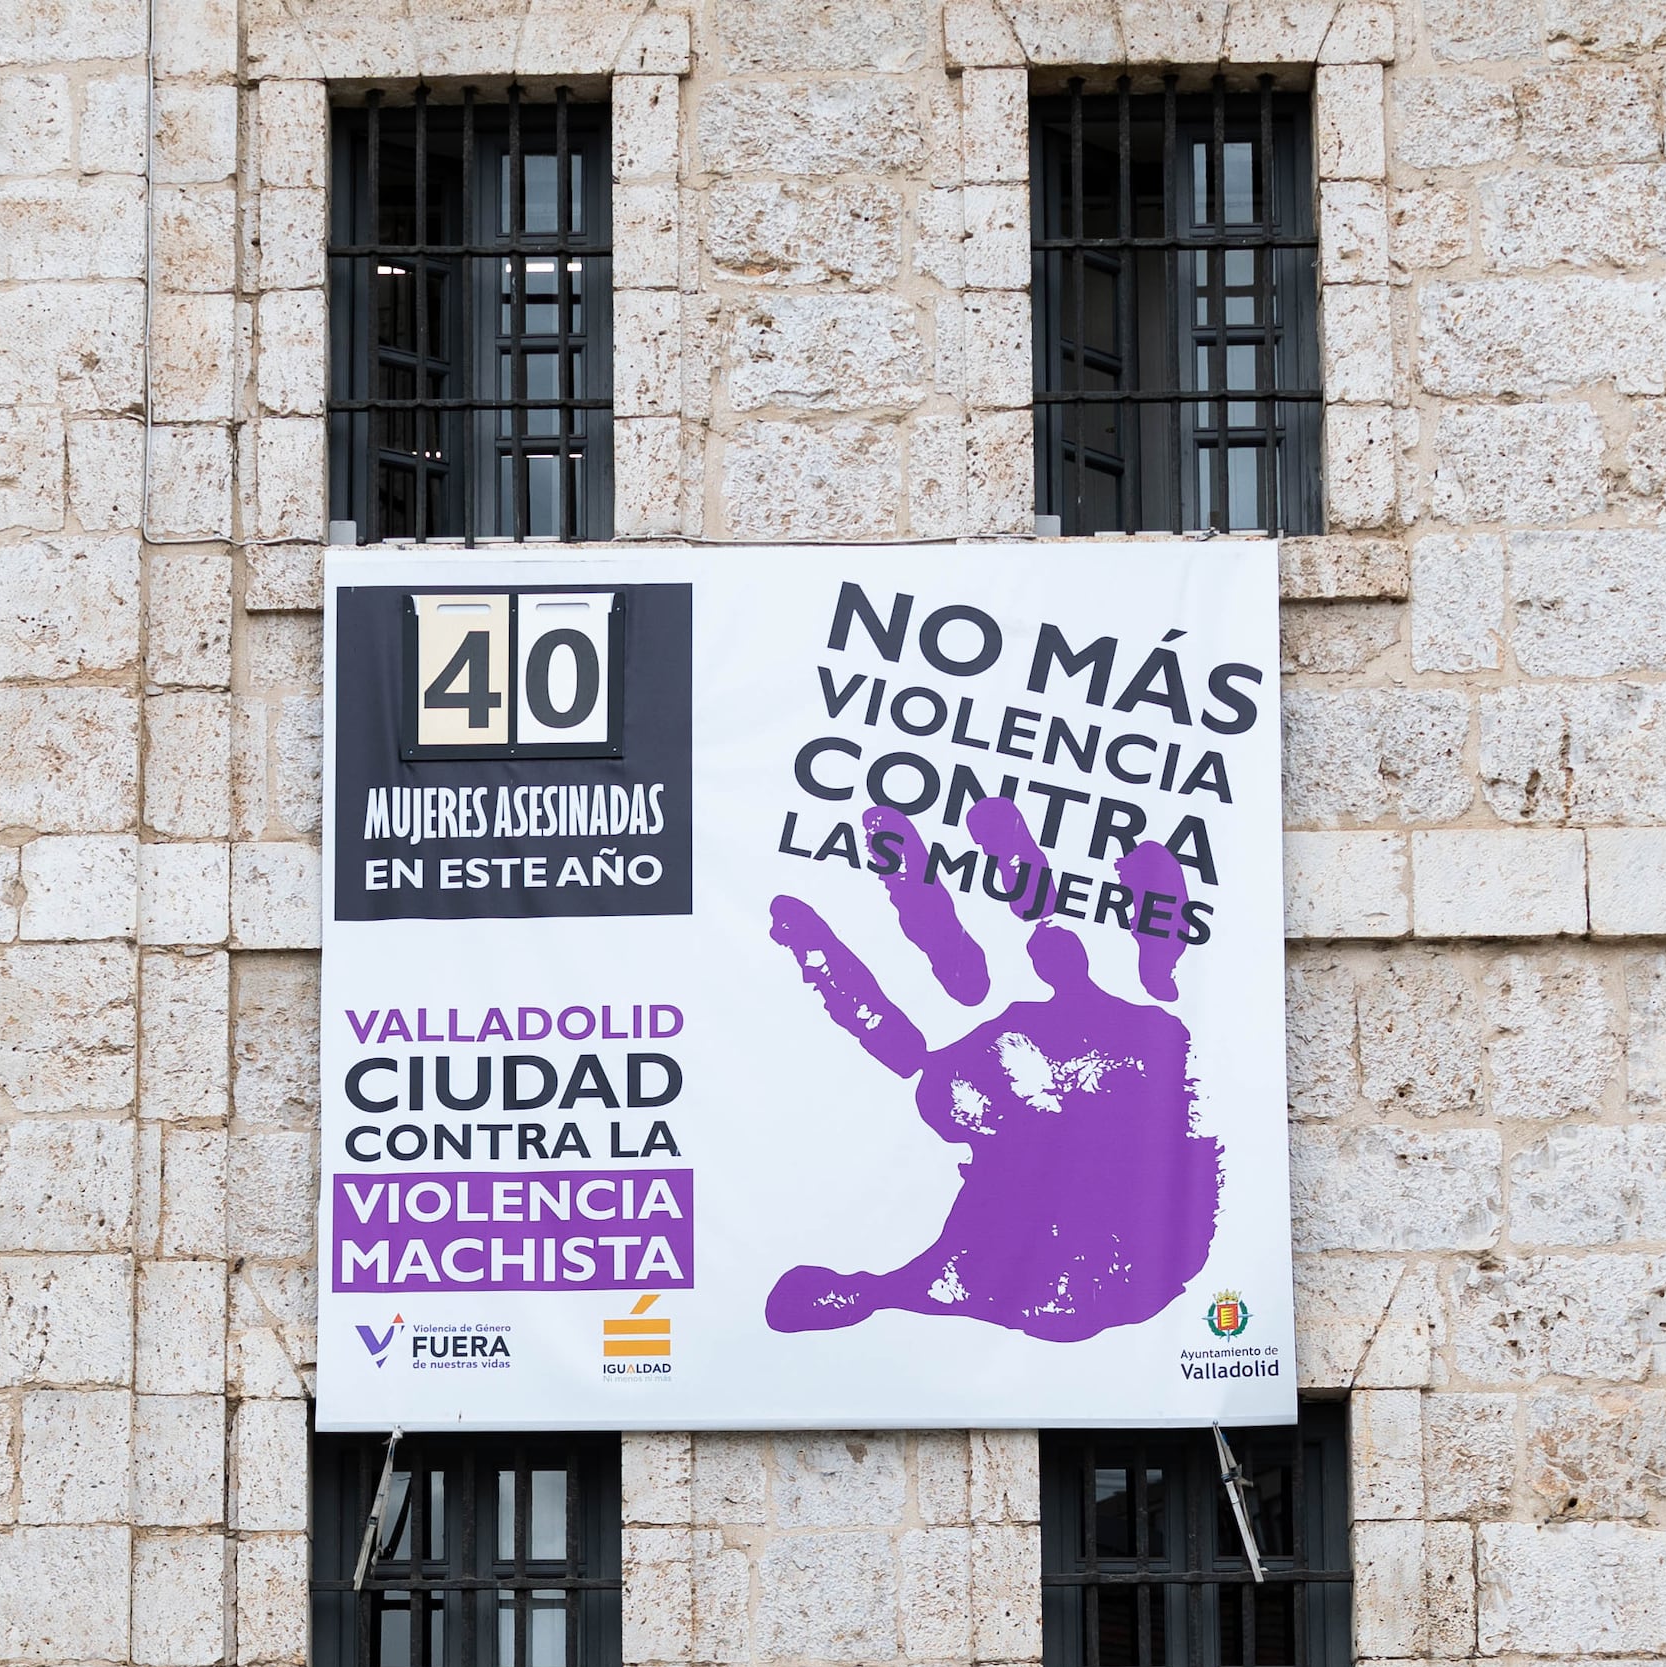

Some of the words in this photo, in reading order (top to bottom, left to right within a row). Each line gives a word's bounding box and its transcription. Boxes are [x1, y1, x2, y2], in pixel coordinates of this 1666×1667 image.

[424, 628, 600, 729] 40
[827, 581, 1003, 677] NO
[1027, 622, 1263, 735] MÁS
[817, 666, 1234, 804] VIOLENCIA
[364, 786, 488, 845] MUJERES
[493, 783, 665, 839] ASESINADAS
[794, 736, 1219, 886] CONTRA
[365, 858, 424, 890] EN
[439, 856, 547, 890] ESTE
[555, 847, 663, 887] AÑO
[778, 811, 905, 875] LAS
[923, 842, 1215, 945] MUJERES
[344, 1004, 685, 1044] VALLADOLID
[344, 1052, 683, 1113] CIUDAD
[345, 1122, 591, 1162] CONTRA
[610, 1120, 682, 1158] LA
[342, 1178, 684, 1224] VIOLENCIA
[341, 1235, 685, 1284] MACHISTA
[412, 1335, 511, 1358] FUERA
[413, 1324, 457, 1333] Violencia
[460, 1323, 473, 1333] de
[475, 1323, 511, 1333] Género
[412, 1359, 427, 1369] de
[430, 1360, 478, 1369] nuestras
[481, 1359, 511, 1369] vidas
[603, 1363, 672, 1374] IGUALDAD
[1180, 1347, 1261, 1360] Ayuntamiento
[1264, 1346, 1279, 1356] de
[1180, 1359, 1279, 1380] Valladolid
